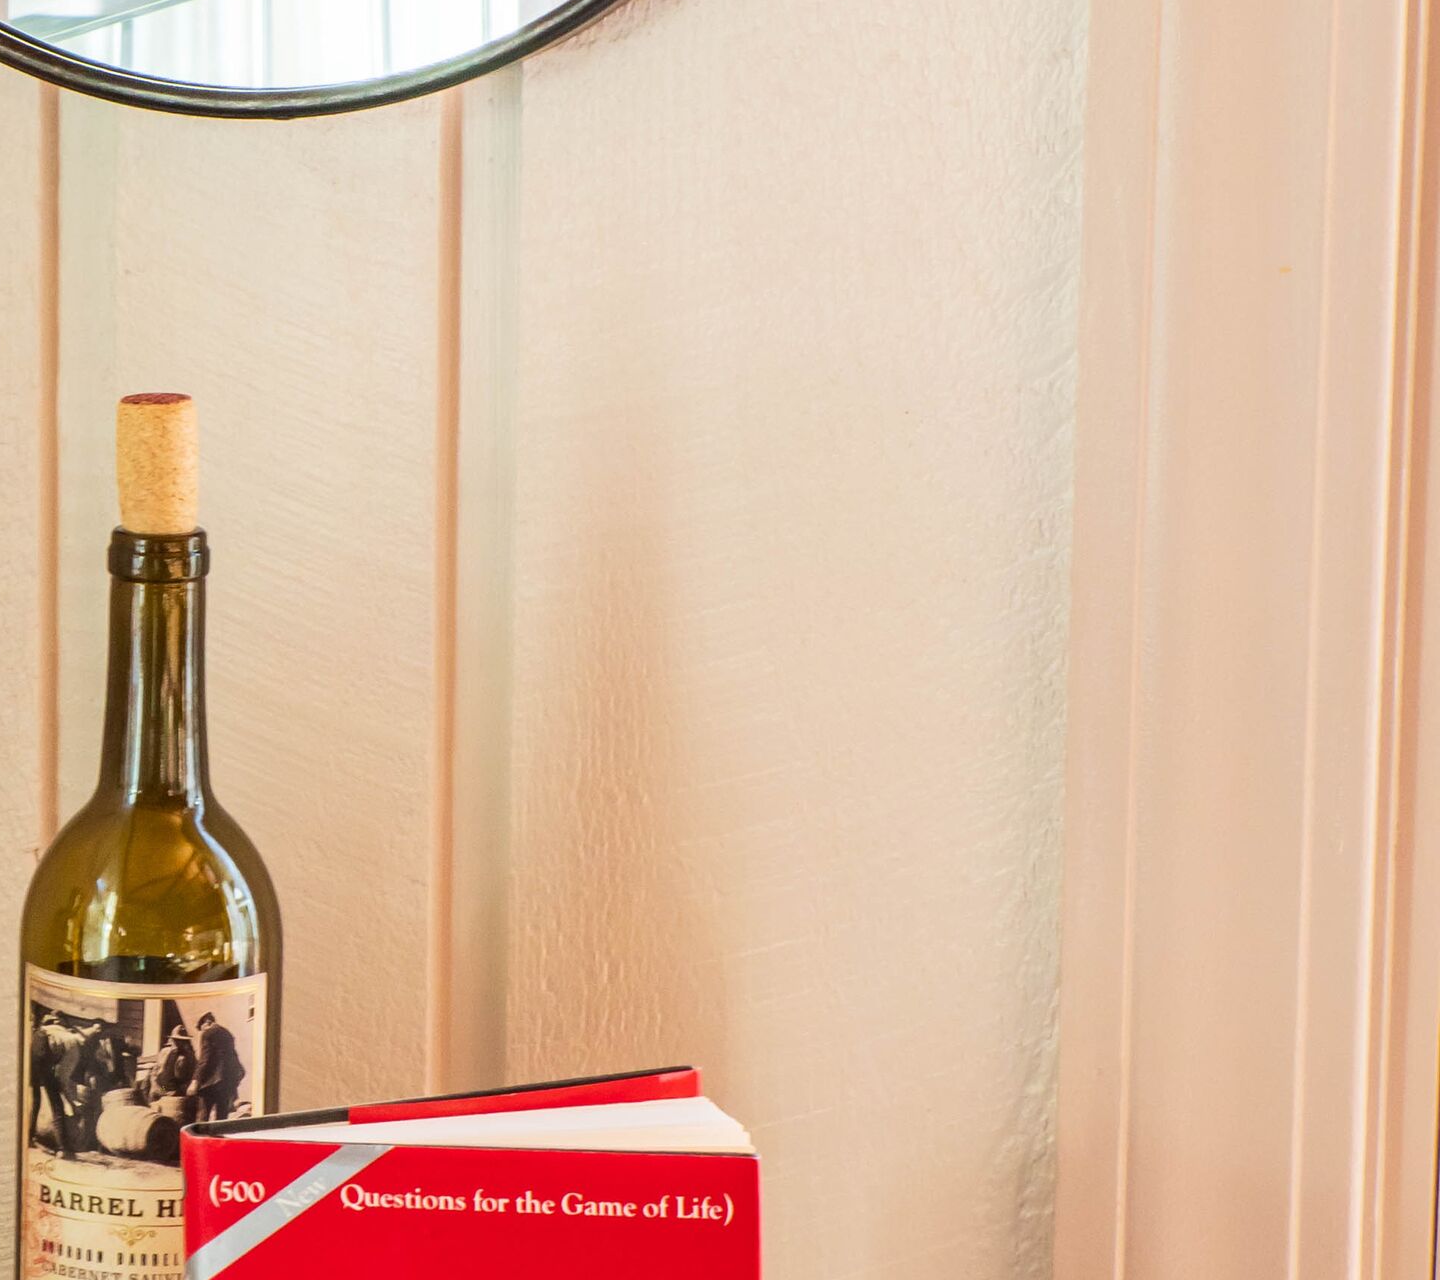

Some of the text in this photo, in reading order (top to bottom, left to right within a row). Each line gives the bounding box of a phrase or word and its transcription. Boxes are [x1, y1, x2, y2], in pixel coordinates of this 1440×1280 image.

[38, 1184, 144, 1218] BARREL
[209, 1173, 266, 1210] (500
[339, 1183, 467, 1213] Questions
[472, 1187, 510, 1212] for
[515, 1189, 557, 1214] the
[561, 1191, 637, 1217] Game
[642, 1192, 670, 1218] of
[675, 1193, 735, 1225] Life)
[116, 1251, 180, 1267] BARREL
